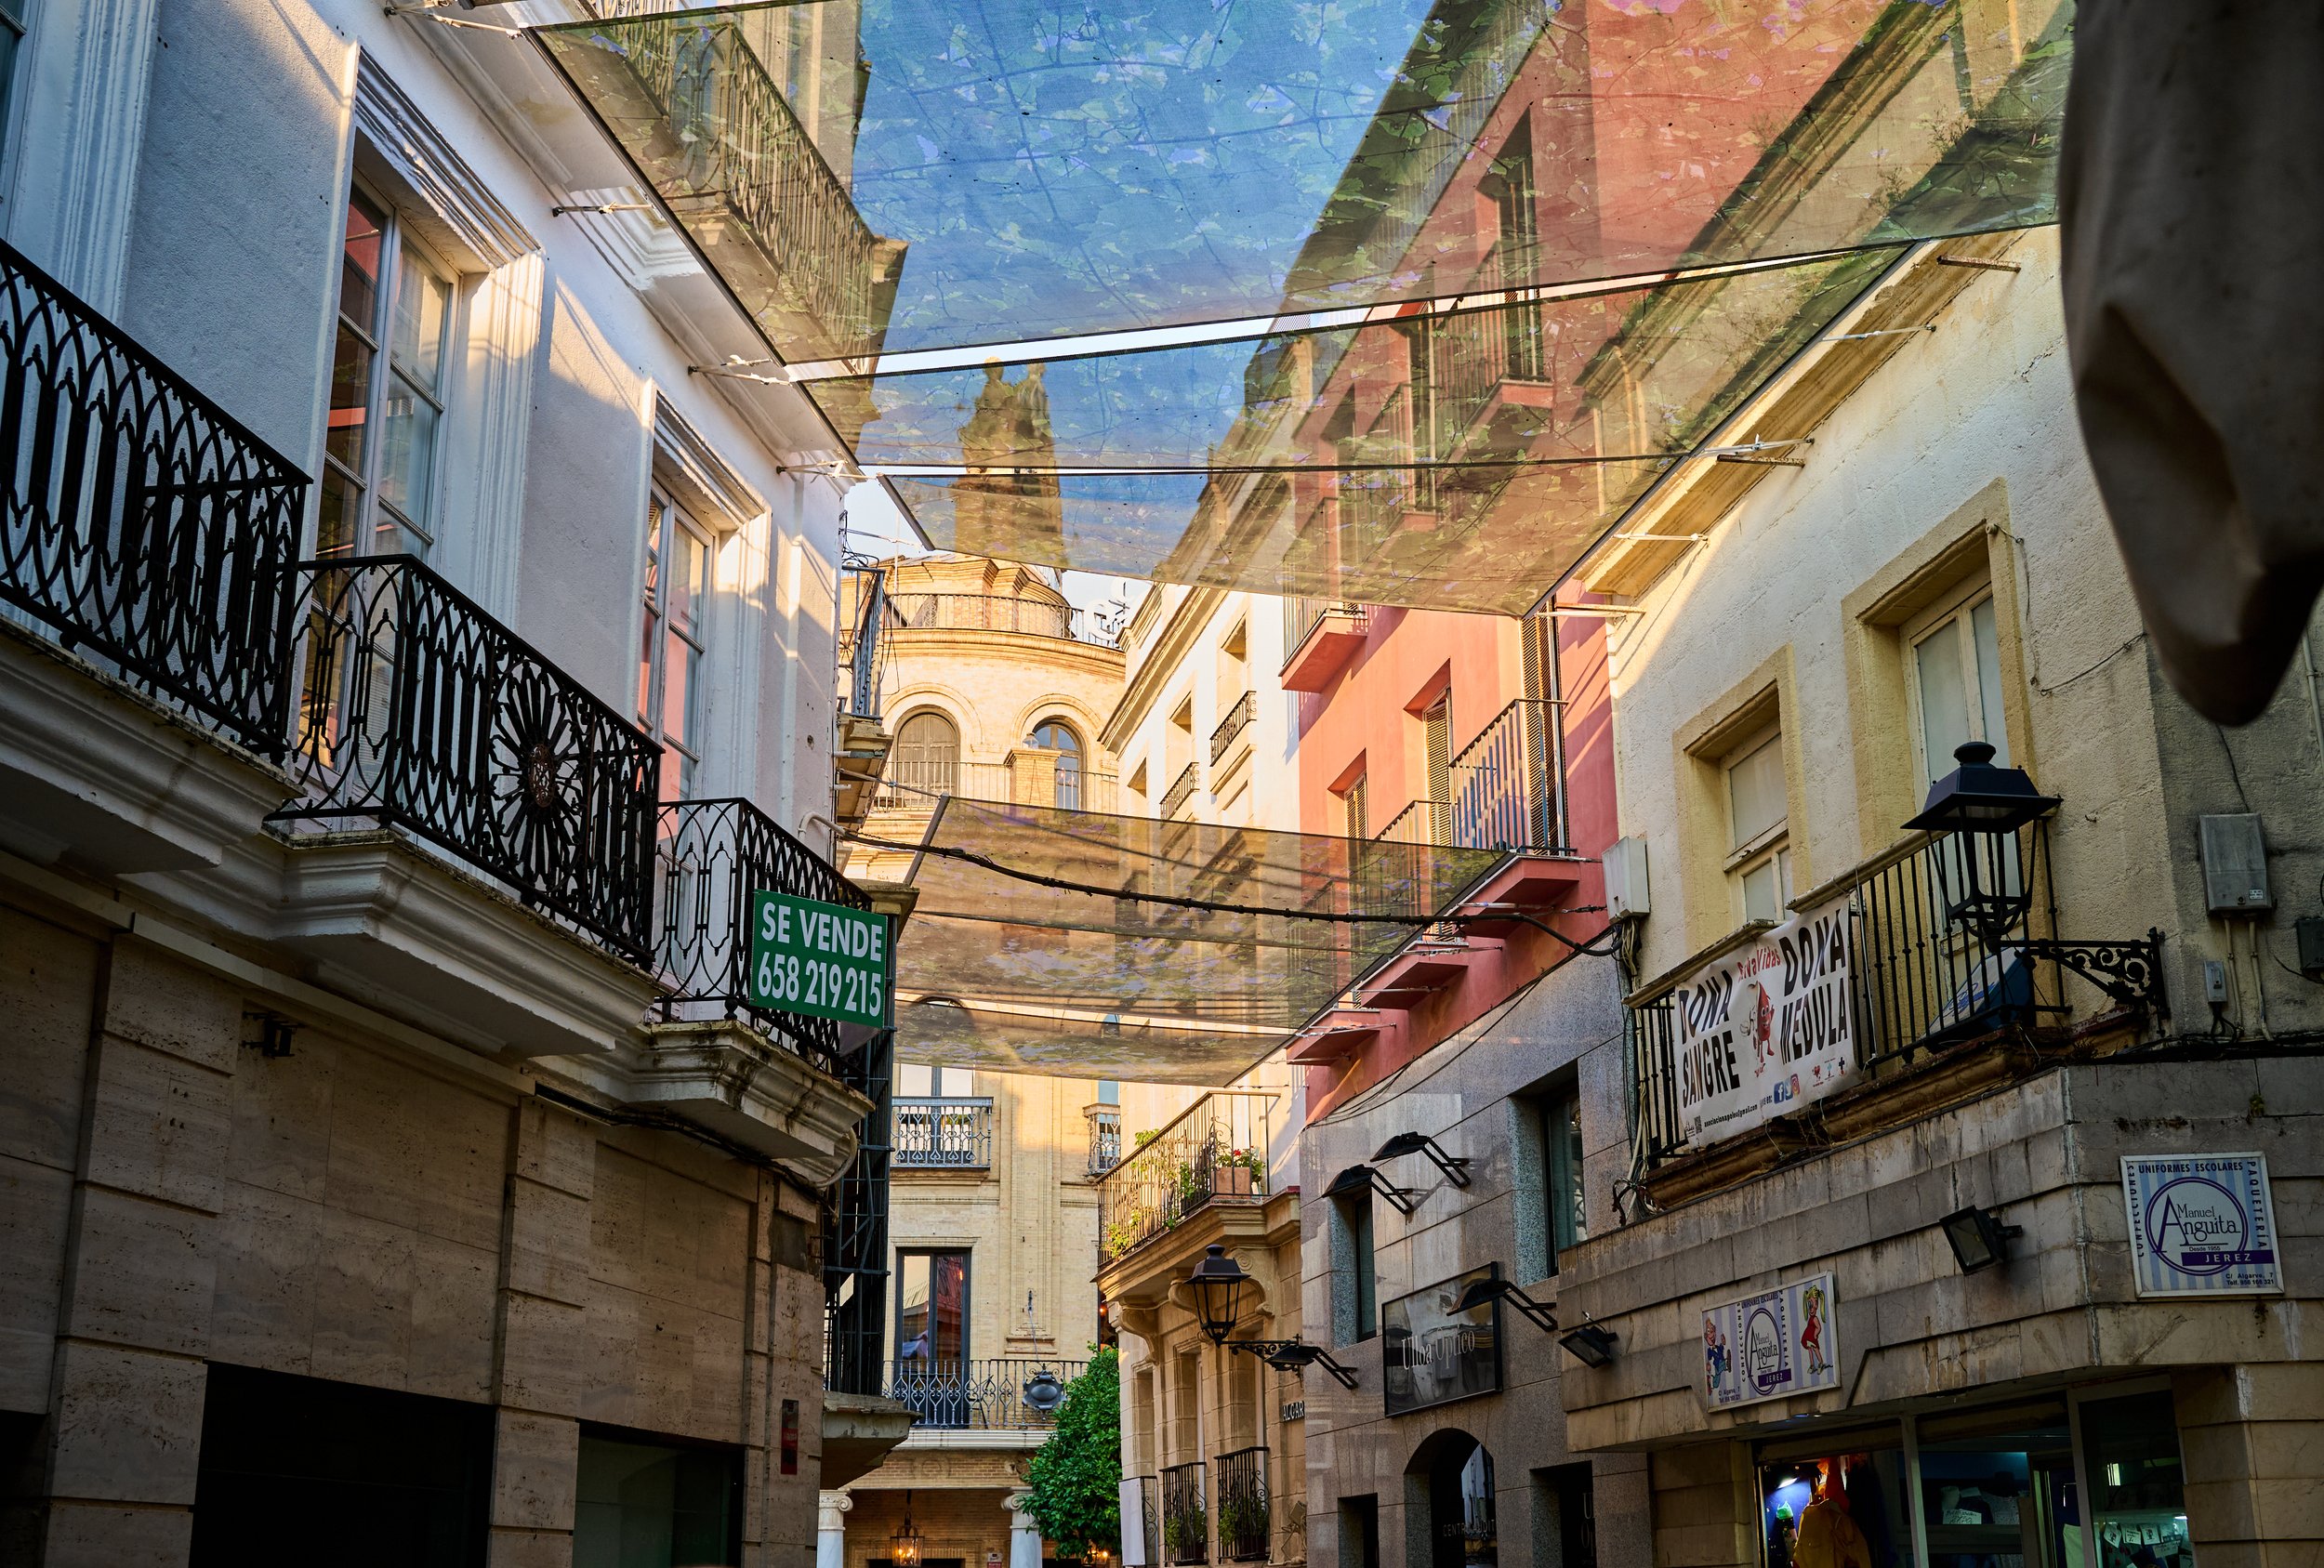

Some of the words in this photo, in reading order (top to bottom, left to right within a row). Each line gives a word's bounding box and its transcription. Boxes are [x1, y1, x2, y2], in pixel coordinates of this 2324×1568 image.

[761, 902, 791, 943] SE
[799, 909, 883, 962] VENDE
[1778, 908, 1846, 996] DONA
[758, 952, 799, 1002] 658
[804, 959, 842, 1008] 219
[844, 967, 881, 1017] 215
[1678, 969, 1733, 1045] DONA
[1779, 977, 1848, 1065] MEDULA
[1683, 1030, 1740, 1108] SANGRE
[2138, 1163, 2191, 1174] UNIFORMES
[2195, 1161, 2243, 1172] ESCOLARES
[2152, 1193, 2242, 1254] Anguita
[2176, 1204, 2215, 1219] Manuel
[2247, 1161, 2269, 1248] PAQUETERÍA
[2205, 1253, 2251, 1263] JEREZ
[1401, 1335, 1433, 1370] Ulloa
[1766, 1374, 1784, 1384] JEREZ
